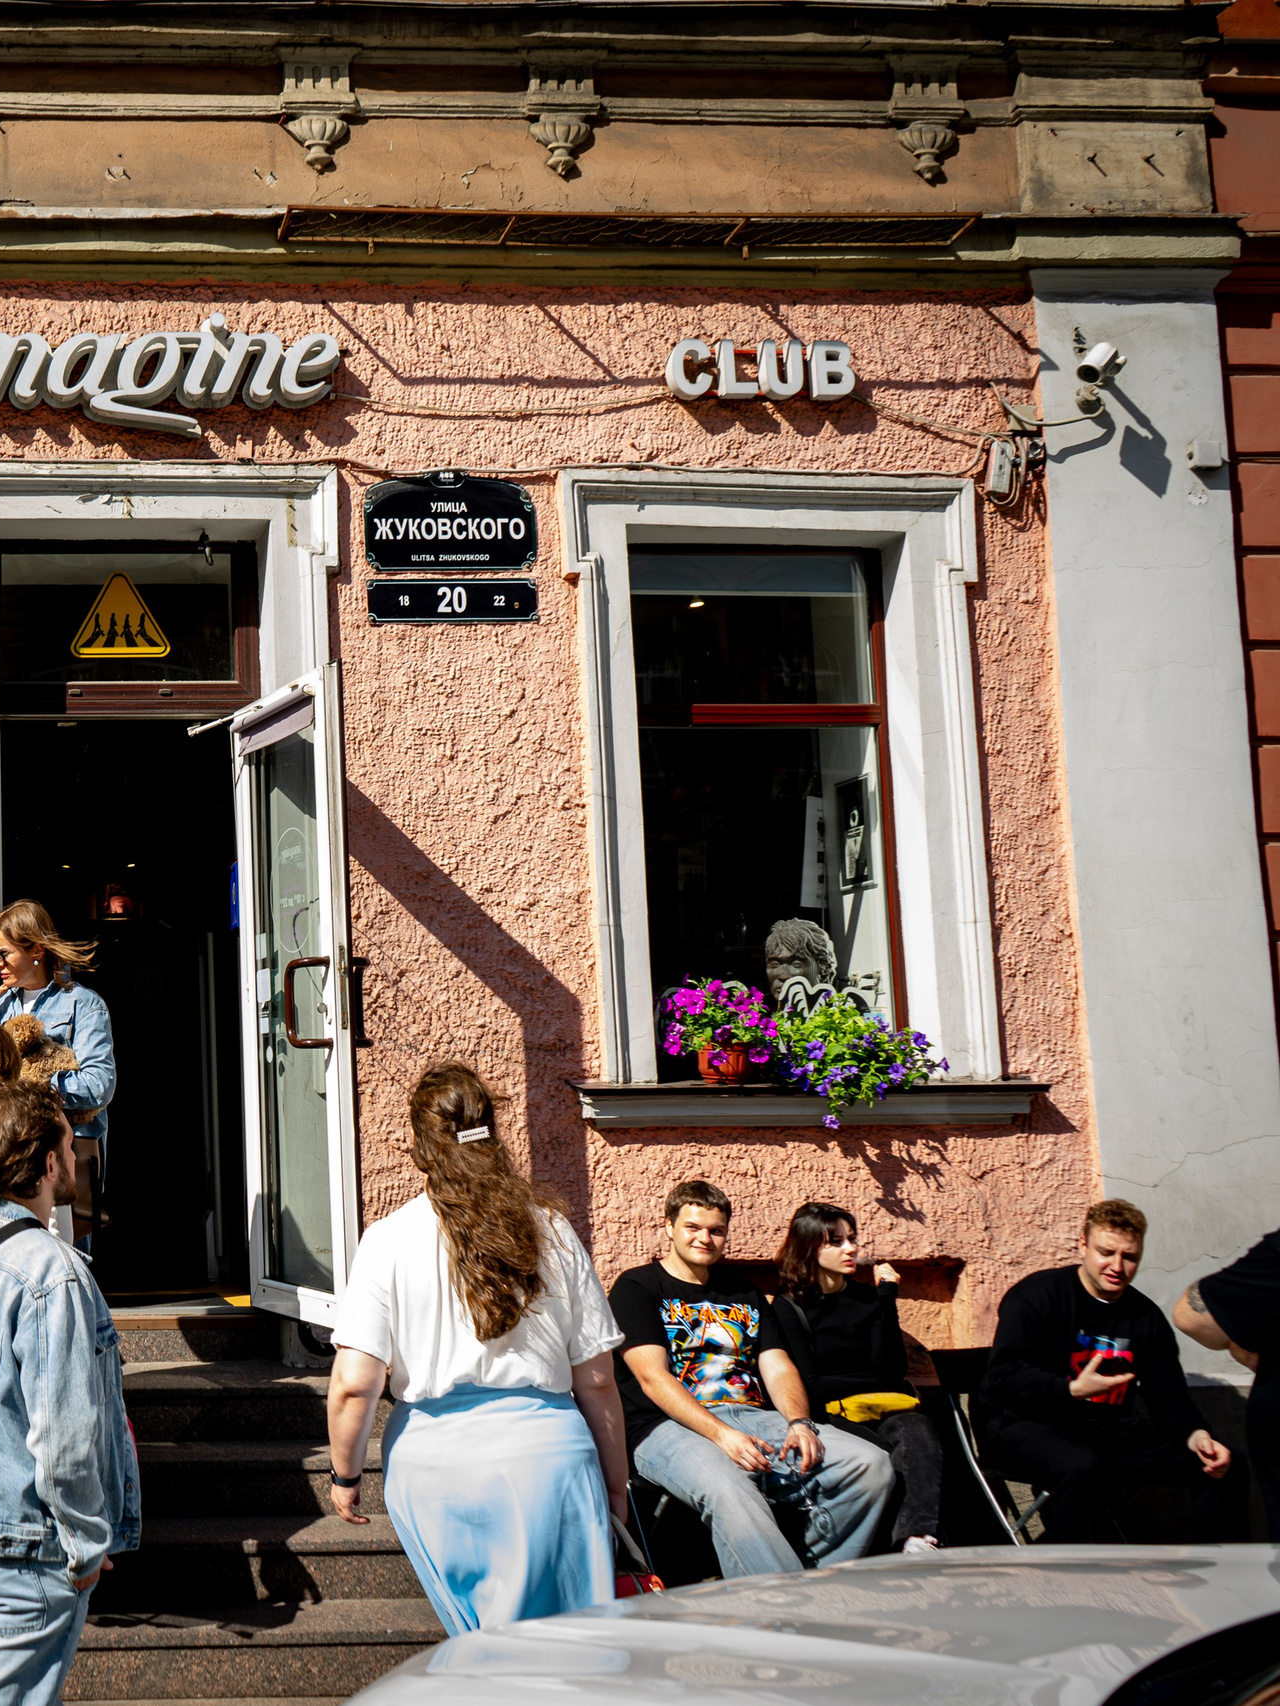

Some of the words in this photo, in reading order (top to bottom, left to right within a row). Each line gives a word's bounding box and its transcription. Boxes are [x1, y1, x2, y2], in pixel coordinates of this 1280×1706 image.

[665, 338, 856, 401] CLUB
[430, 502, 468, 514] УЛИЦА
[373, 518, 525, 540] ЖУКОВСКОГО
[411, 554, 435, 562] ULITSA
[438, 553, 490, 561] ZHUKOVSKOGO
[398, 595, 410, 606] 18
[436, 586, 468, 613] 20
[493, 595, 506, 606] 22
